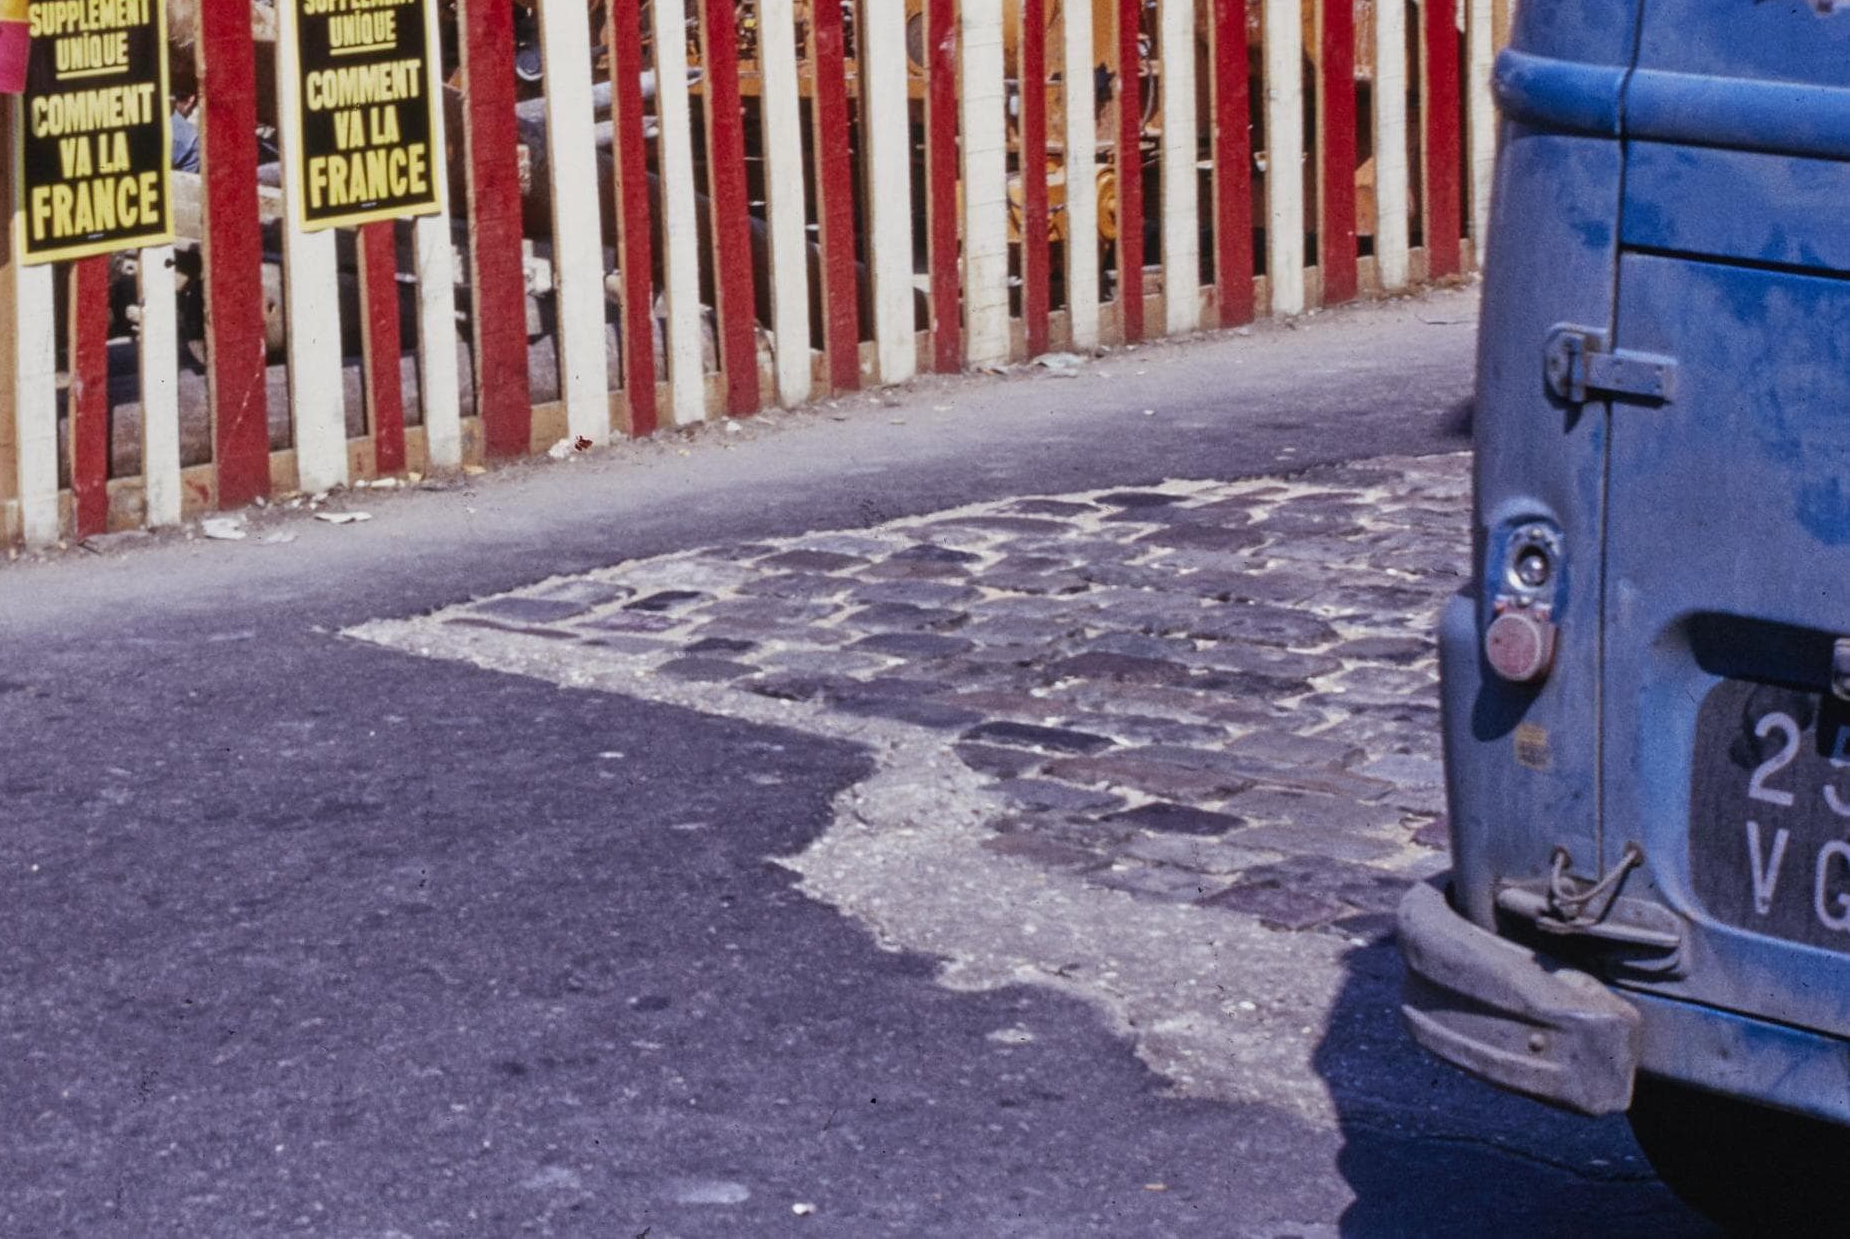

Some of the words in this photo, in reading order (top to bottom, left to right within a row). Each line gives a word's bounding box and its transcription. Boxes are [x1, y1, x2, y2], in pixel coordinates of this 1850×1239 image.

[55, 31, 129, 72] UNIQUE
[328, 9, 397, 49] UNIQUE
[306, 58, 421, 111] COMMENT
[30, 82, 155, 138] COMMENT
[332, 110, 365, 150] VA
[370, 104, 400, 144] LA
[59, 138, 93, 179] VA
[98, 132, 130, 173] LA
[309, 143, 428, 208] FRANCE
[31, 171, 160, 241] FRANCE
